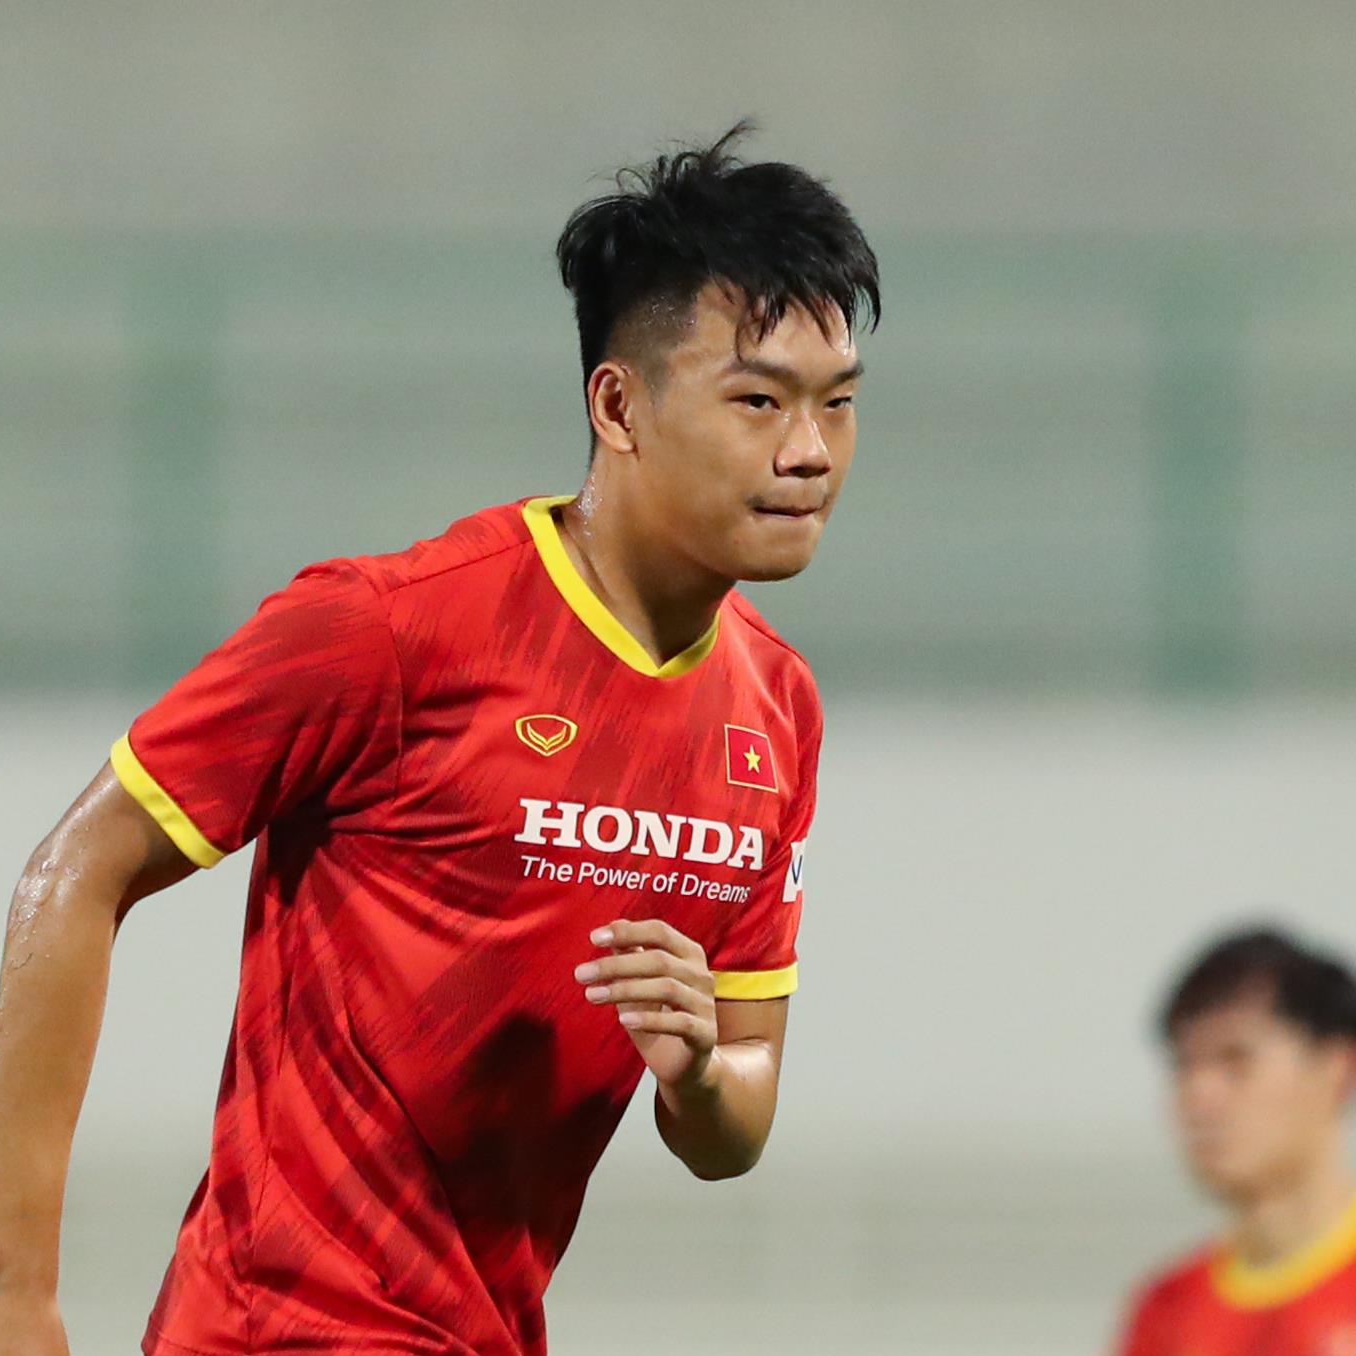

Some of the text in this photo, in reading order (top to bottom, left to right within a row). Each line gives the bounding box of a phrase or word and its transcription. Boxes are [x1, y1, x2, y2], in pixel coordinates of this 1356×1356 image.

[514, 798, 764, 871] HONDA
[521, 855, 751, 904] The Power of Dreams
